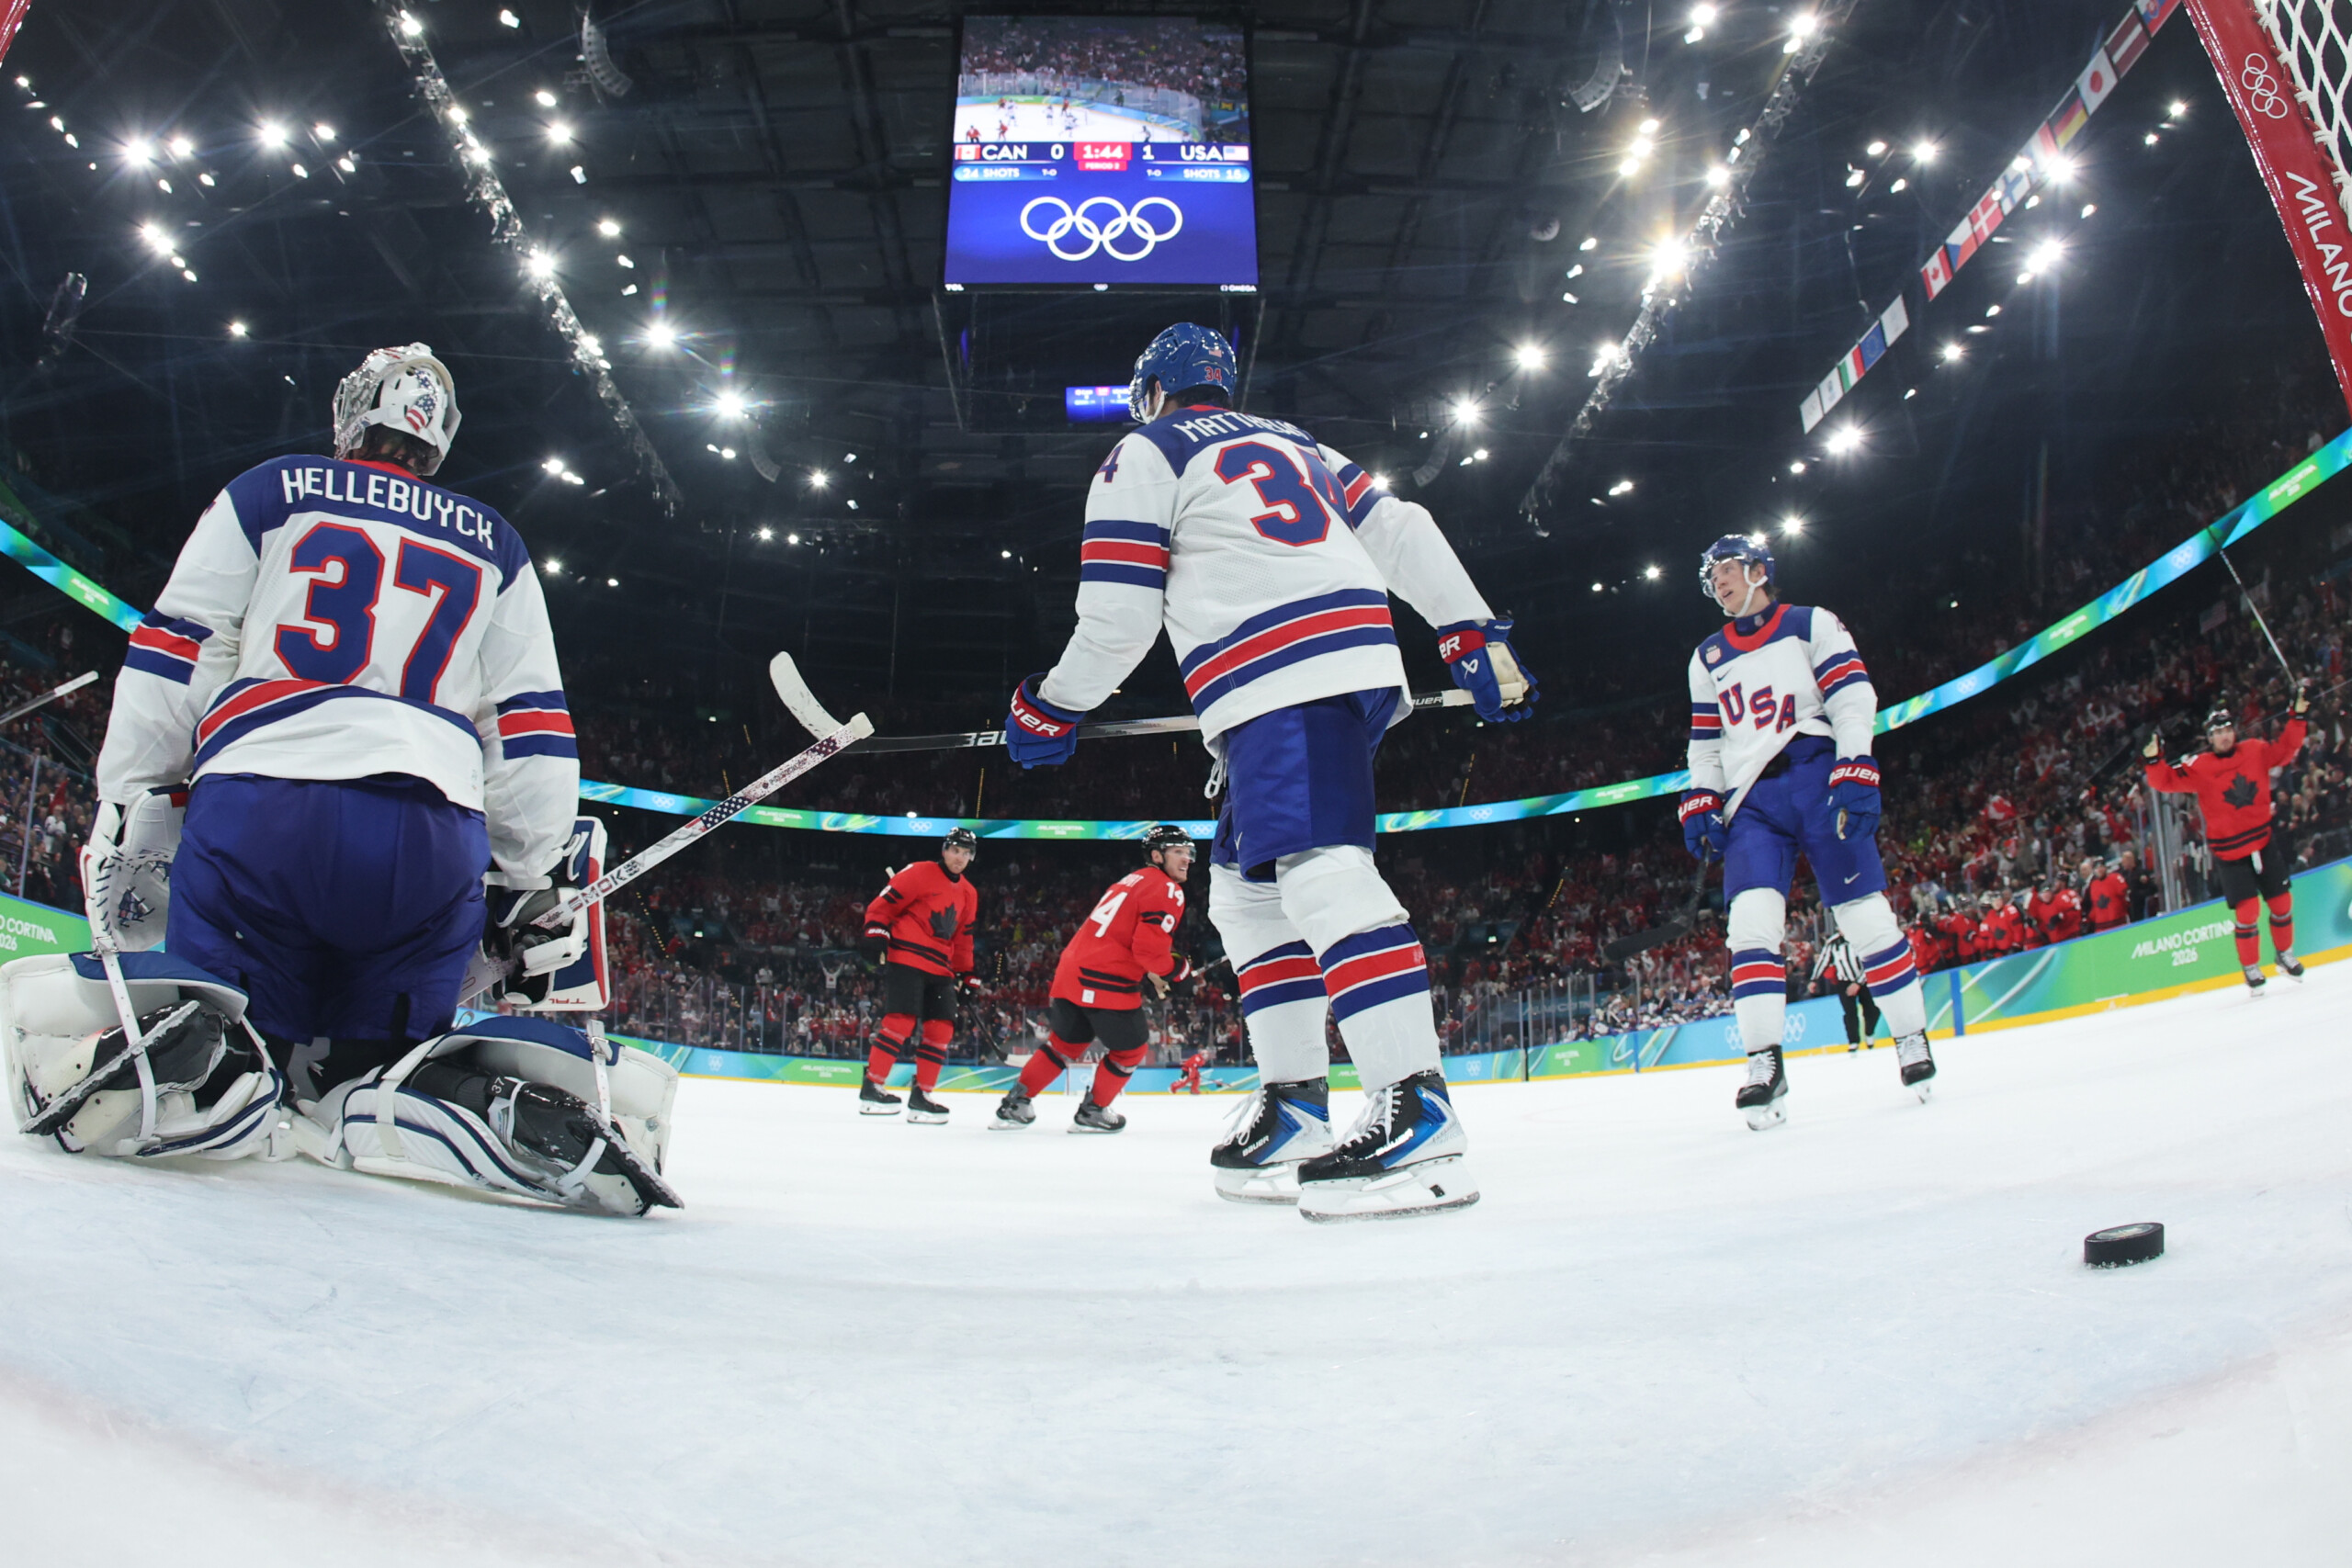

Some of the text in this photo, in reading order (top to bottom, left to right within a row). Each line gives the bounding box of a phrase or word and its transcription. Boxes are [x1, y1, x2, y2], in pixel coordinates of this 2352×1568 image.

[981, 144, 1027, 160] CAN
[1051, 143, 1064, 160] 0
[1083, 144, 1124, 159] 1:44
[1142, 144, 1155, 160] 1
[1181, 145, 1223, 161] USA
[963, 168, 1020, 178] 24 SHOTS
[1183, 169, 1220, 179] SHOTS
[1204, 367, 1222, 383] 34
[281, 468, 493, 550] HELLEBUYCK
[274, 521, 482, 705] 37
[1718, 682, 1797, 734] USA
[1166, 882, 1184, 908] 14
[6, 918, 58, 944] CORTINA
[2132, 932, 2182, 959] MILANO
[2172, 947, 2199, 966] 2026
[492, 1077, 505, 1094] 37
[1242, 1135, 1270, 1157] BAUER
